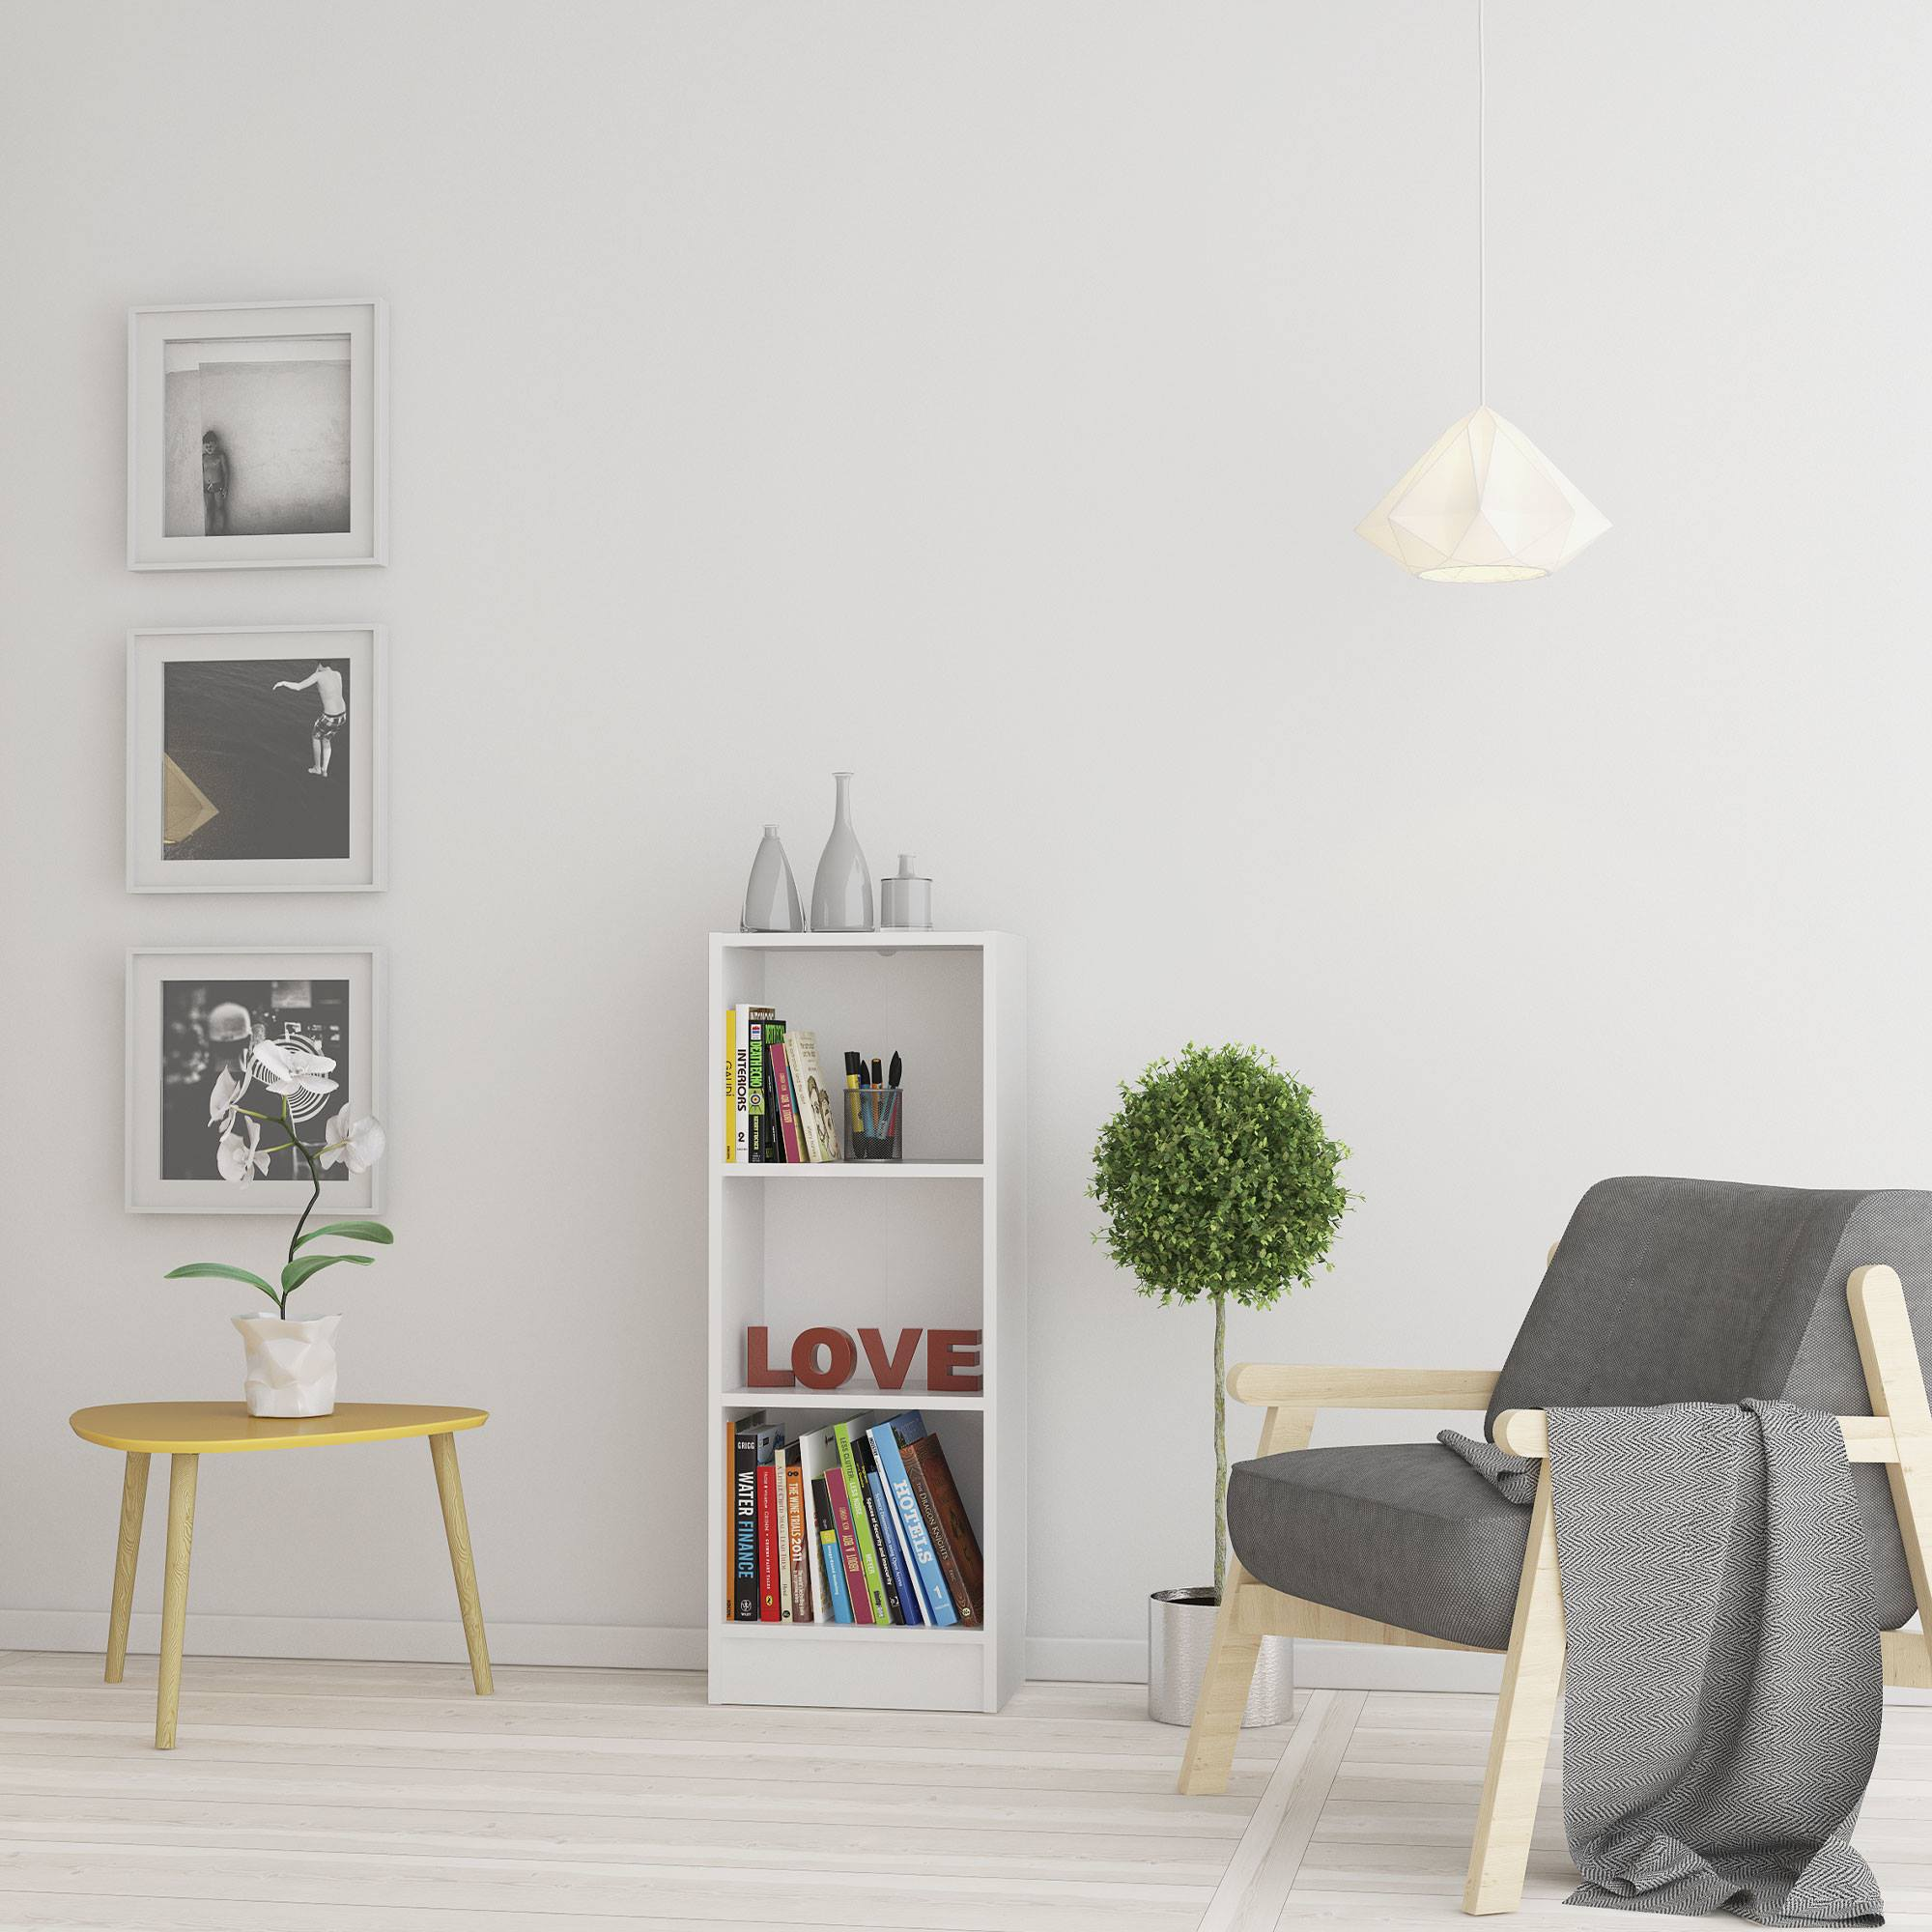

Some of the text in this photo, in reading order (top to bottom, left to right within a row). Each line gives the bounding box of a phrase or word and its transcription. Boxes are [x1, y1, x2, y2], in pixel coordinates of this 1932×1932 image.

[750, 1041, 762, 1065] DEATH
[737, 1049, 747, 1112] INTERIORS
[750, 1067, 762, 1087] ECHO
[738, 1131, 745, 1143] 2
[748, 1325, 983, 1391] LOVE
[737, 1441, 754, 1450] GRIGG
[839, 1436, 848, 1453] LESS
[875, 1492, 884, 1511] Science
[738, 1471, 754, 1578] WATER FINANCE
[788, 1483, 803, 1562] THE WINE TRIALS 2011
[894, 1480, 932, 1565] HOTELS
[919, 1492, 936, 1525] DRAGON
[931, 1525, 950, 1560] KNIGHTS
[872, 1523, 882, 1548] Security
[933, 1584, 942, 1599] 1
